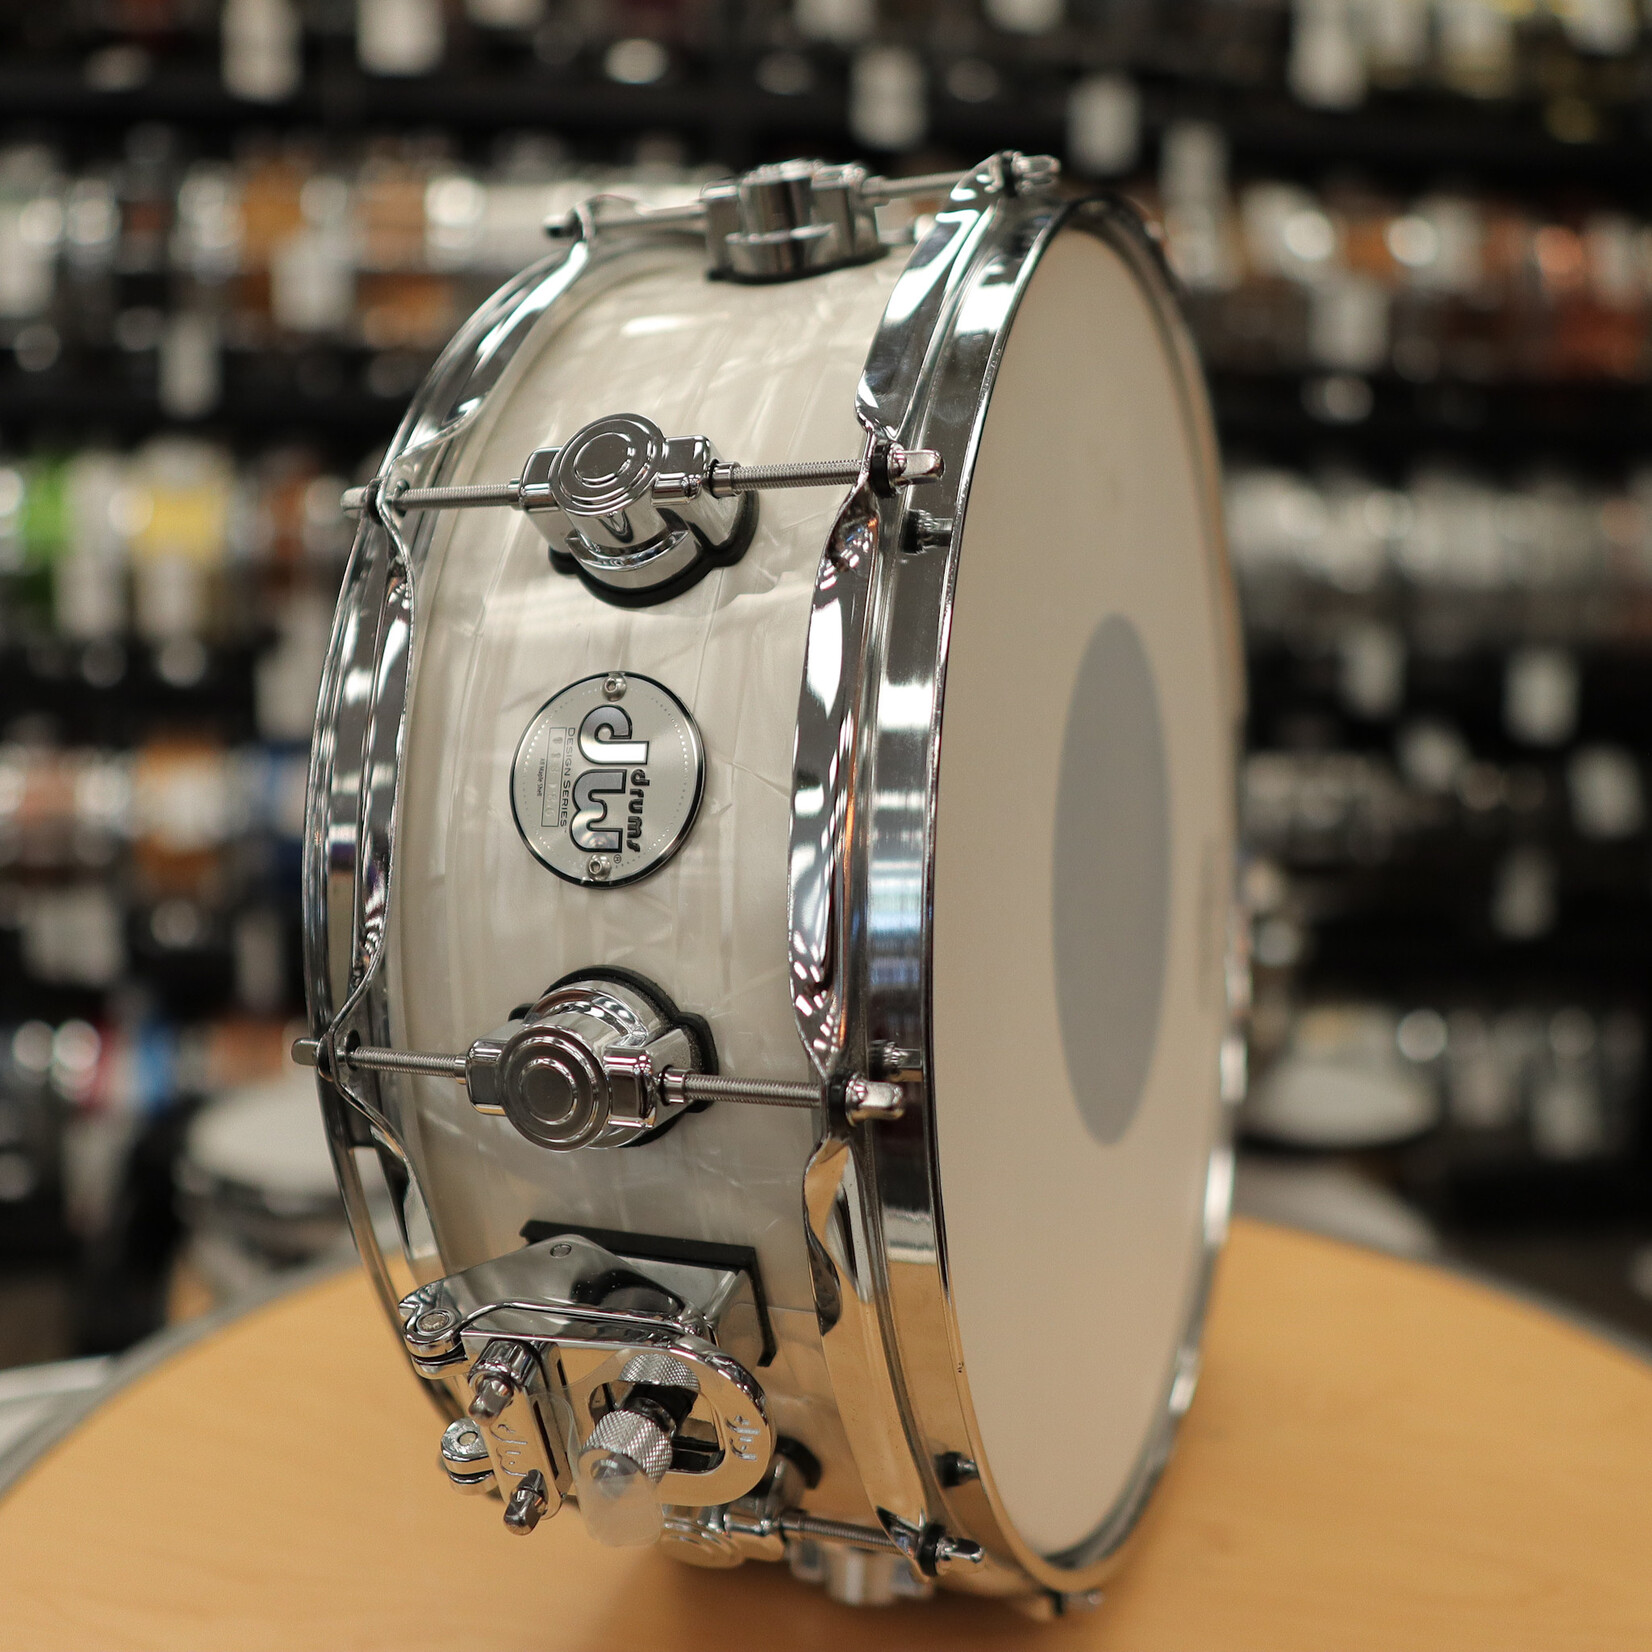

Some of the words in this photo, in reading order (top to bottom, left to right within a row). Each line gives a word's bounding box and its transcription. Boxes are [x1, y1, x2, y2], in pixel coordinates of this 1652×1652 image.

[560, 780, 571, 828] SERIES
[570, 705, 649, 853] dw
[626, 768, 650, 853] drums
